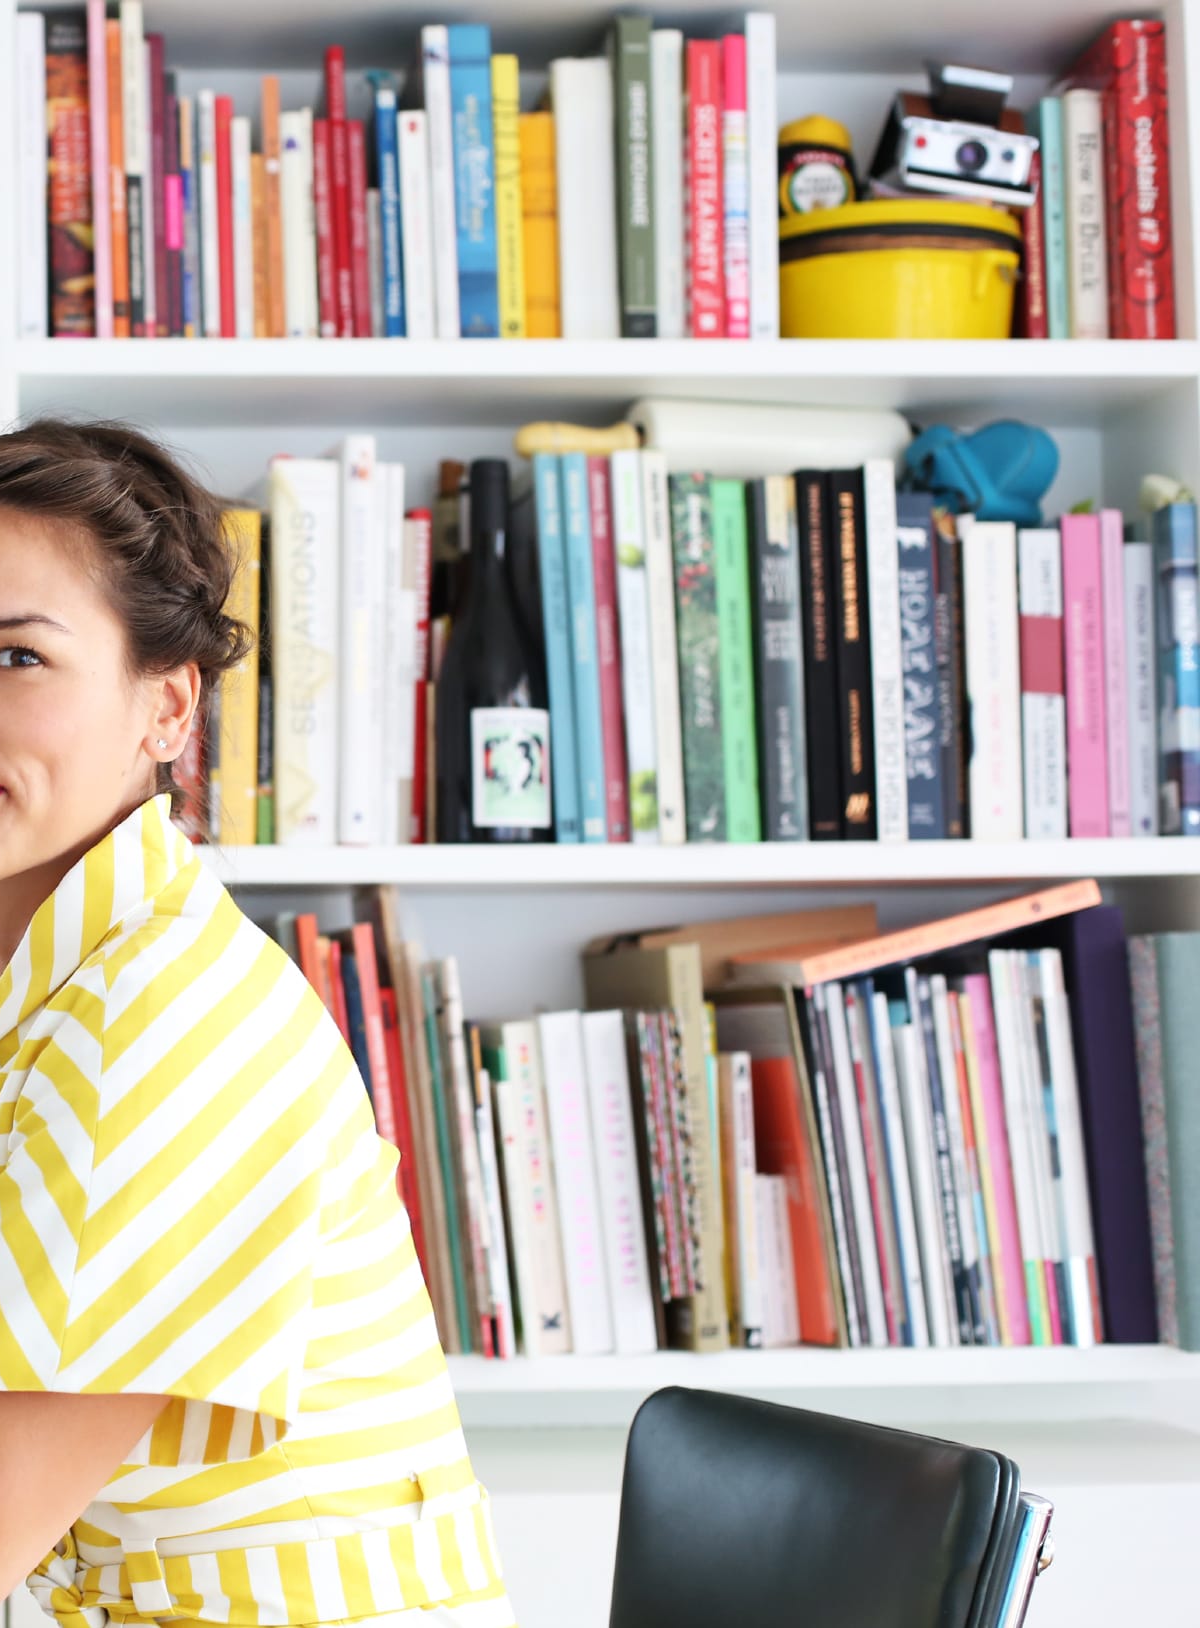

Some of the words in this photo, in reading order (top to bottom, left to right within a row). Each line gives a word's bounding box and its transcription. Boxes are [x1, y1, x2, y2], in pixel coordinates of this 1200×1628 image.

[1080, 132, 1098, 183] How
[1135, 116, 1157, 212] cocktails
[1081, 194, 1097, 216] to
[1139, 217, 1158, 245] #7
[1081, 223, 1100, 291] Drink
